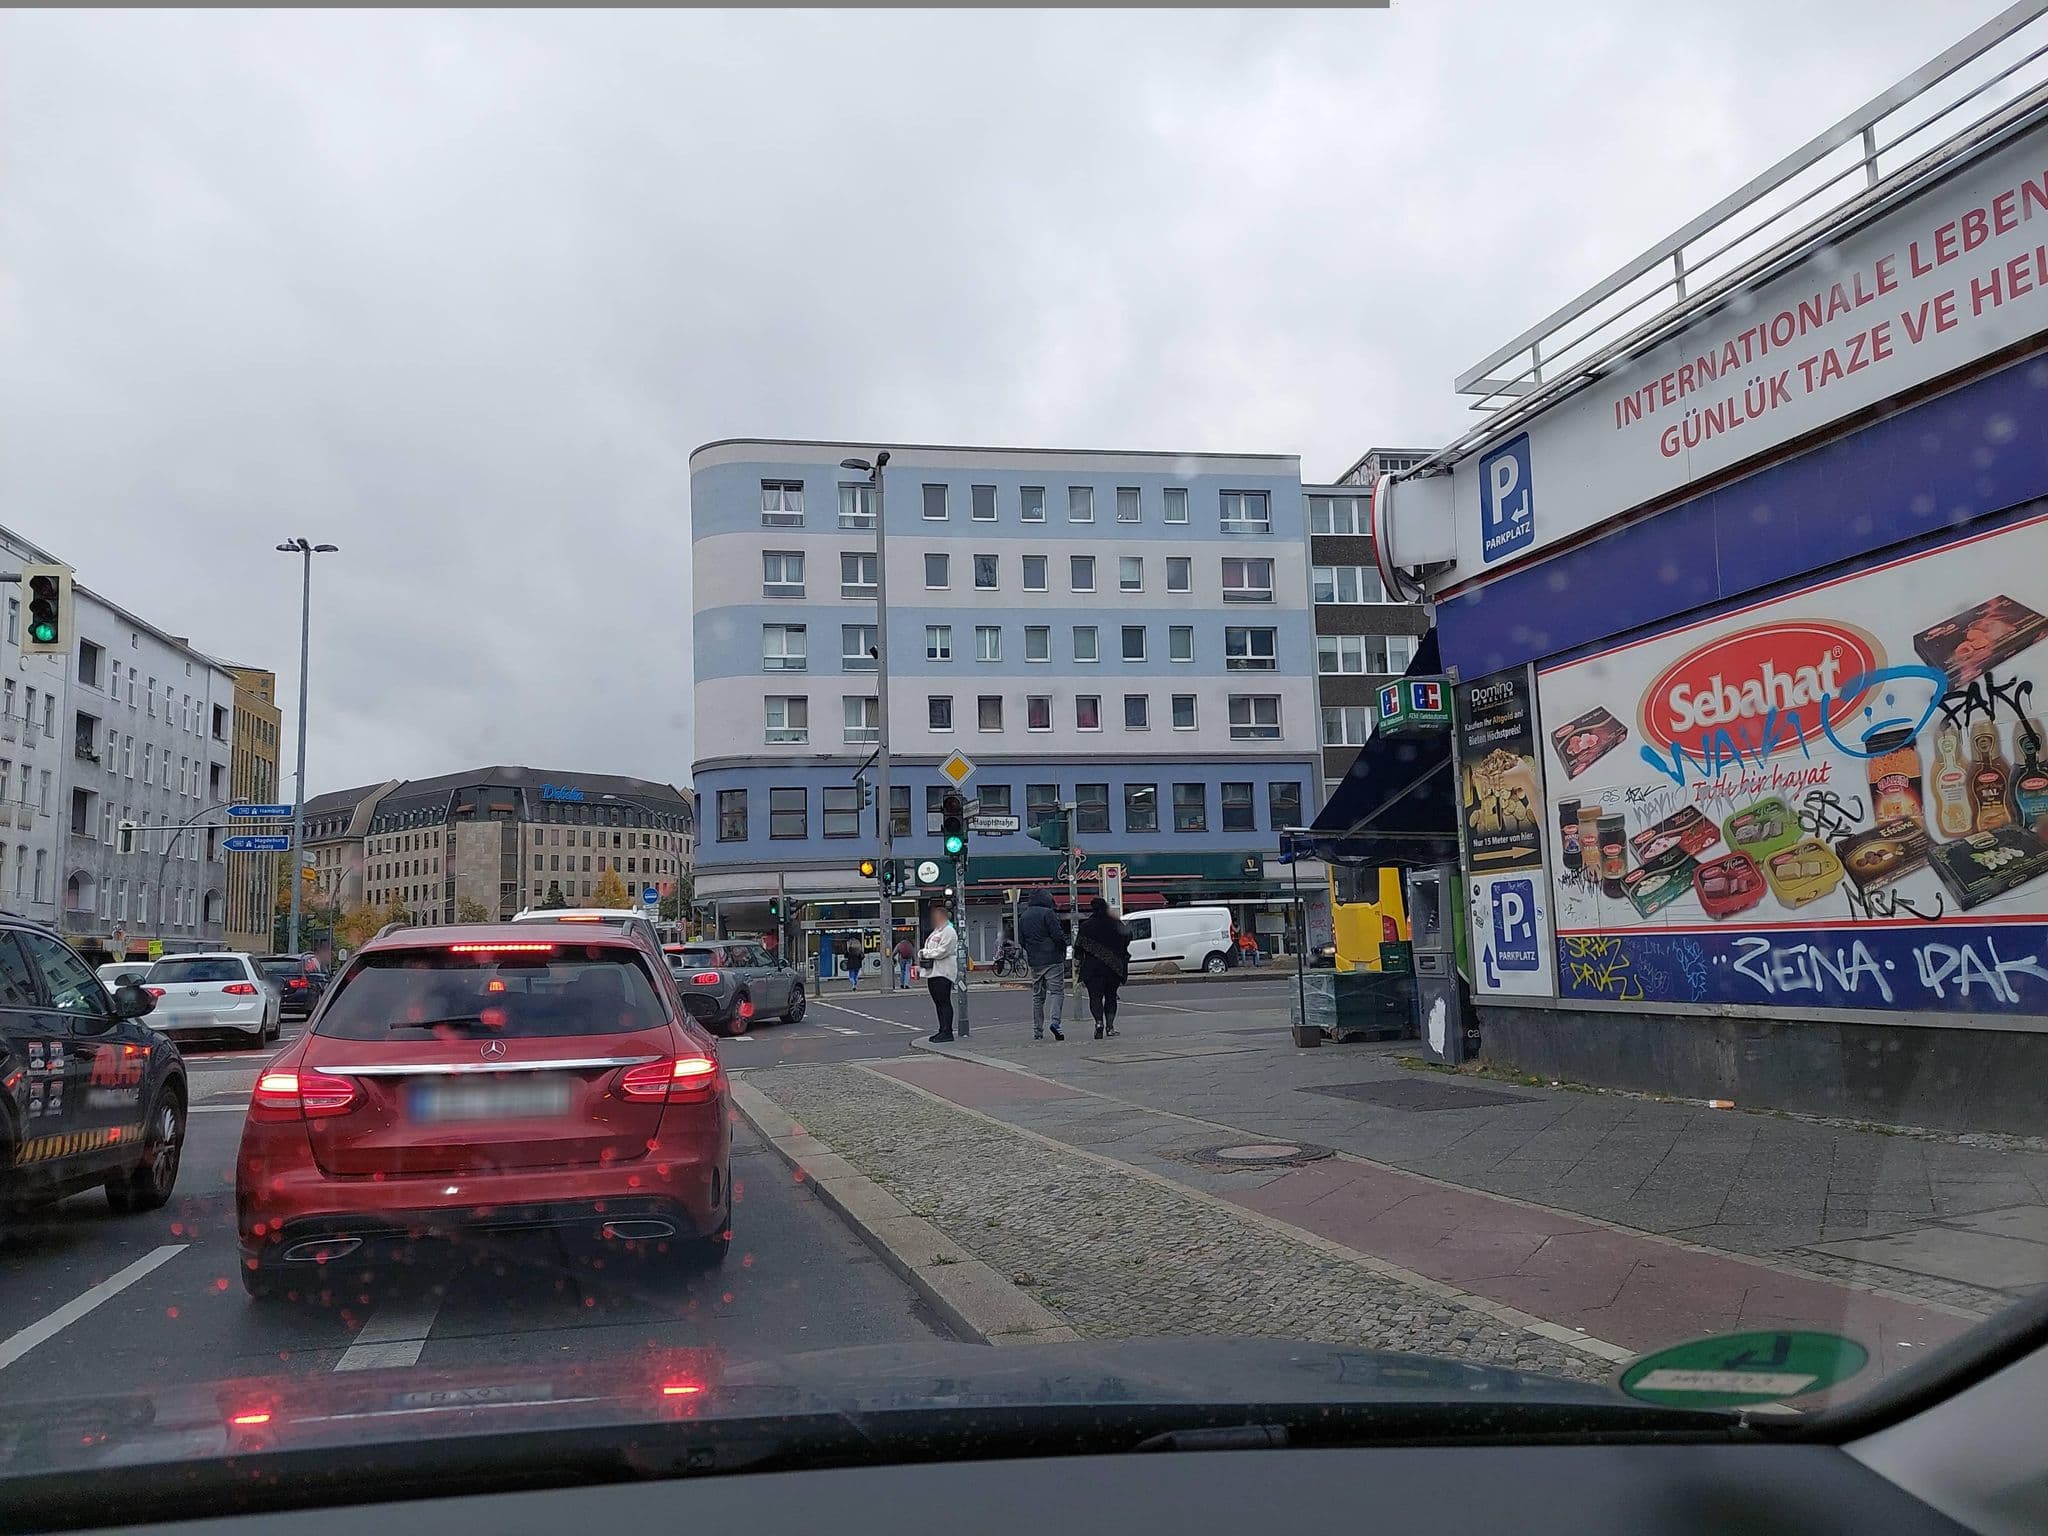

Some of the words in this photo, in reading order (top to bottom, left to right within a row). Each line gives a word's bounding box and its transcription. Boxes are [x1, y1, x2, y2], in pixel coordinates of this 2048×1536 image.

[1615, 253, 1898, 430] INTERNATIONALE
[1909, 169, 2048, 279] LEBEN
[1660, 376, 1792, 458] GÜNLÜK
[1798, 320, 1893, 394] TAZE
[1901, 290, 1958, 344] VE
[1490, 455, 1519, 525] P
[1486, 521, 1530, 552] PARKPLATZ
[1472, 681, 1513, 702] Domino
[1668, 650, 1842, 733] Sebahat
[1465, 721, 1483, 732] Kaufen
[1484, 718, 1492, 727] Ihr
[1493, 711, 1513, 725] Altgold
[1469, 735, 1487, 746] Bieten
[1772, 760, 1833, 801] hayat
[1473, 838, 1483, 847] Nur
[1484, 837, 1491, 846] 15
[1492, 836, 1508, 844] Meter
[1509, 834, 1520, 842] von
[1502, 893, 1524, 942] P
[1499, 951, 1536, 961] PARKPLATZ
